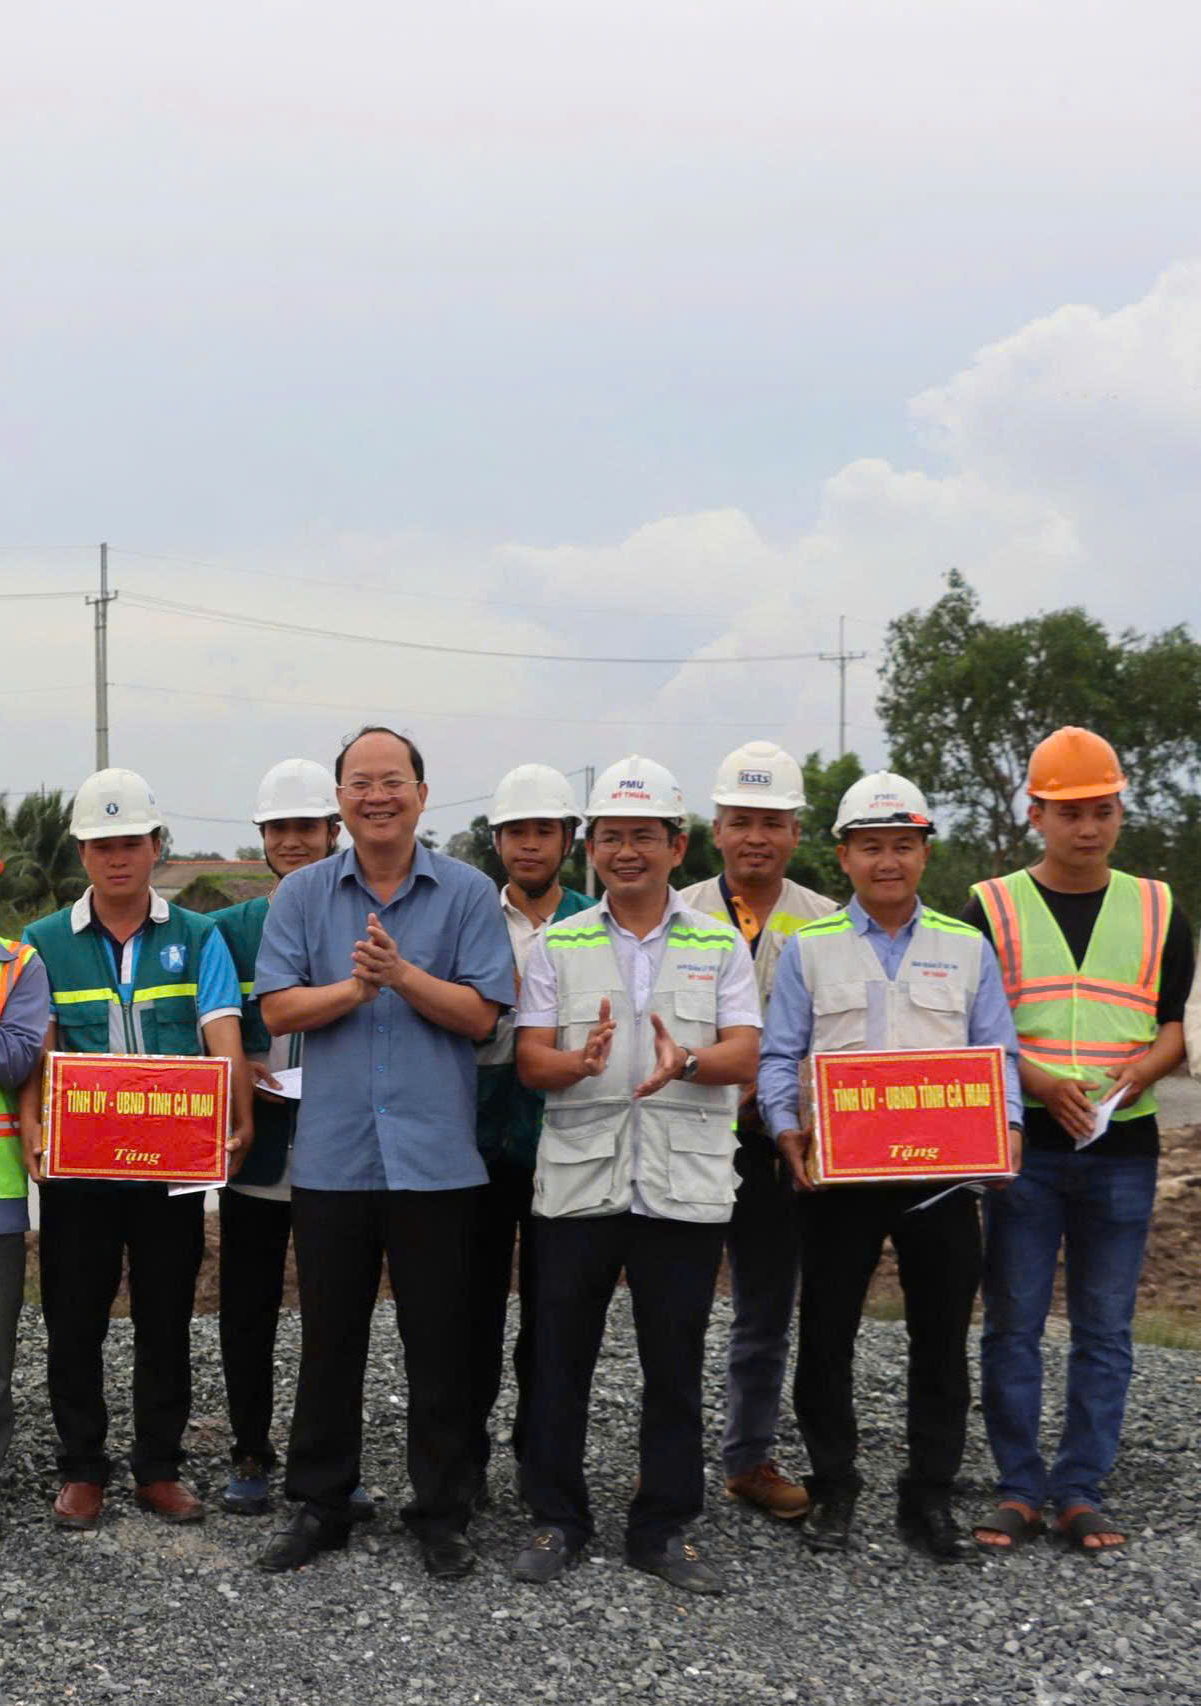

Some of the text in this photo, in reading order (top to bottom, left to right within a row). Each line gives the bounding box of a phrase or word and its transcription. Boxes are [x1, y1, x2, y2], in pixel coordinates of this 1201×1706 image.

[619, 780, 645, 789] PMU
[66, 1082, 91, 1113] TỈNH
[93, 1082, 107, 1114] ỦY
[116, 1091, 145, 1115] UBND
[147, 1084, 172, 1116] TỈNH
[174, 1088, 188, 1116] CÀ
[190, 1094, 215, 1117] MAU
[113, 1148, 162, 1166] Tặng
[888, 1144, 940, 1161] Tặng
